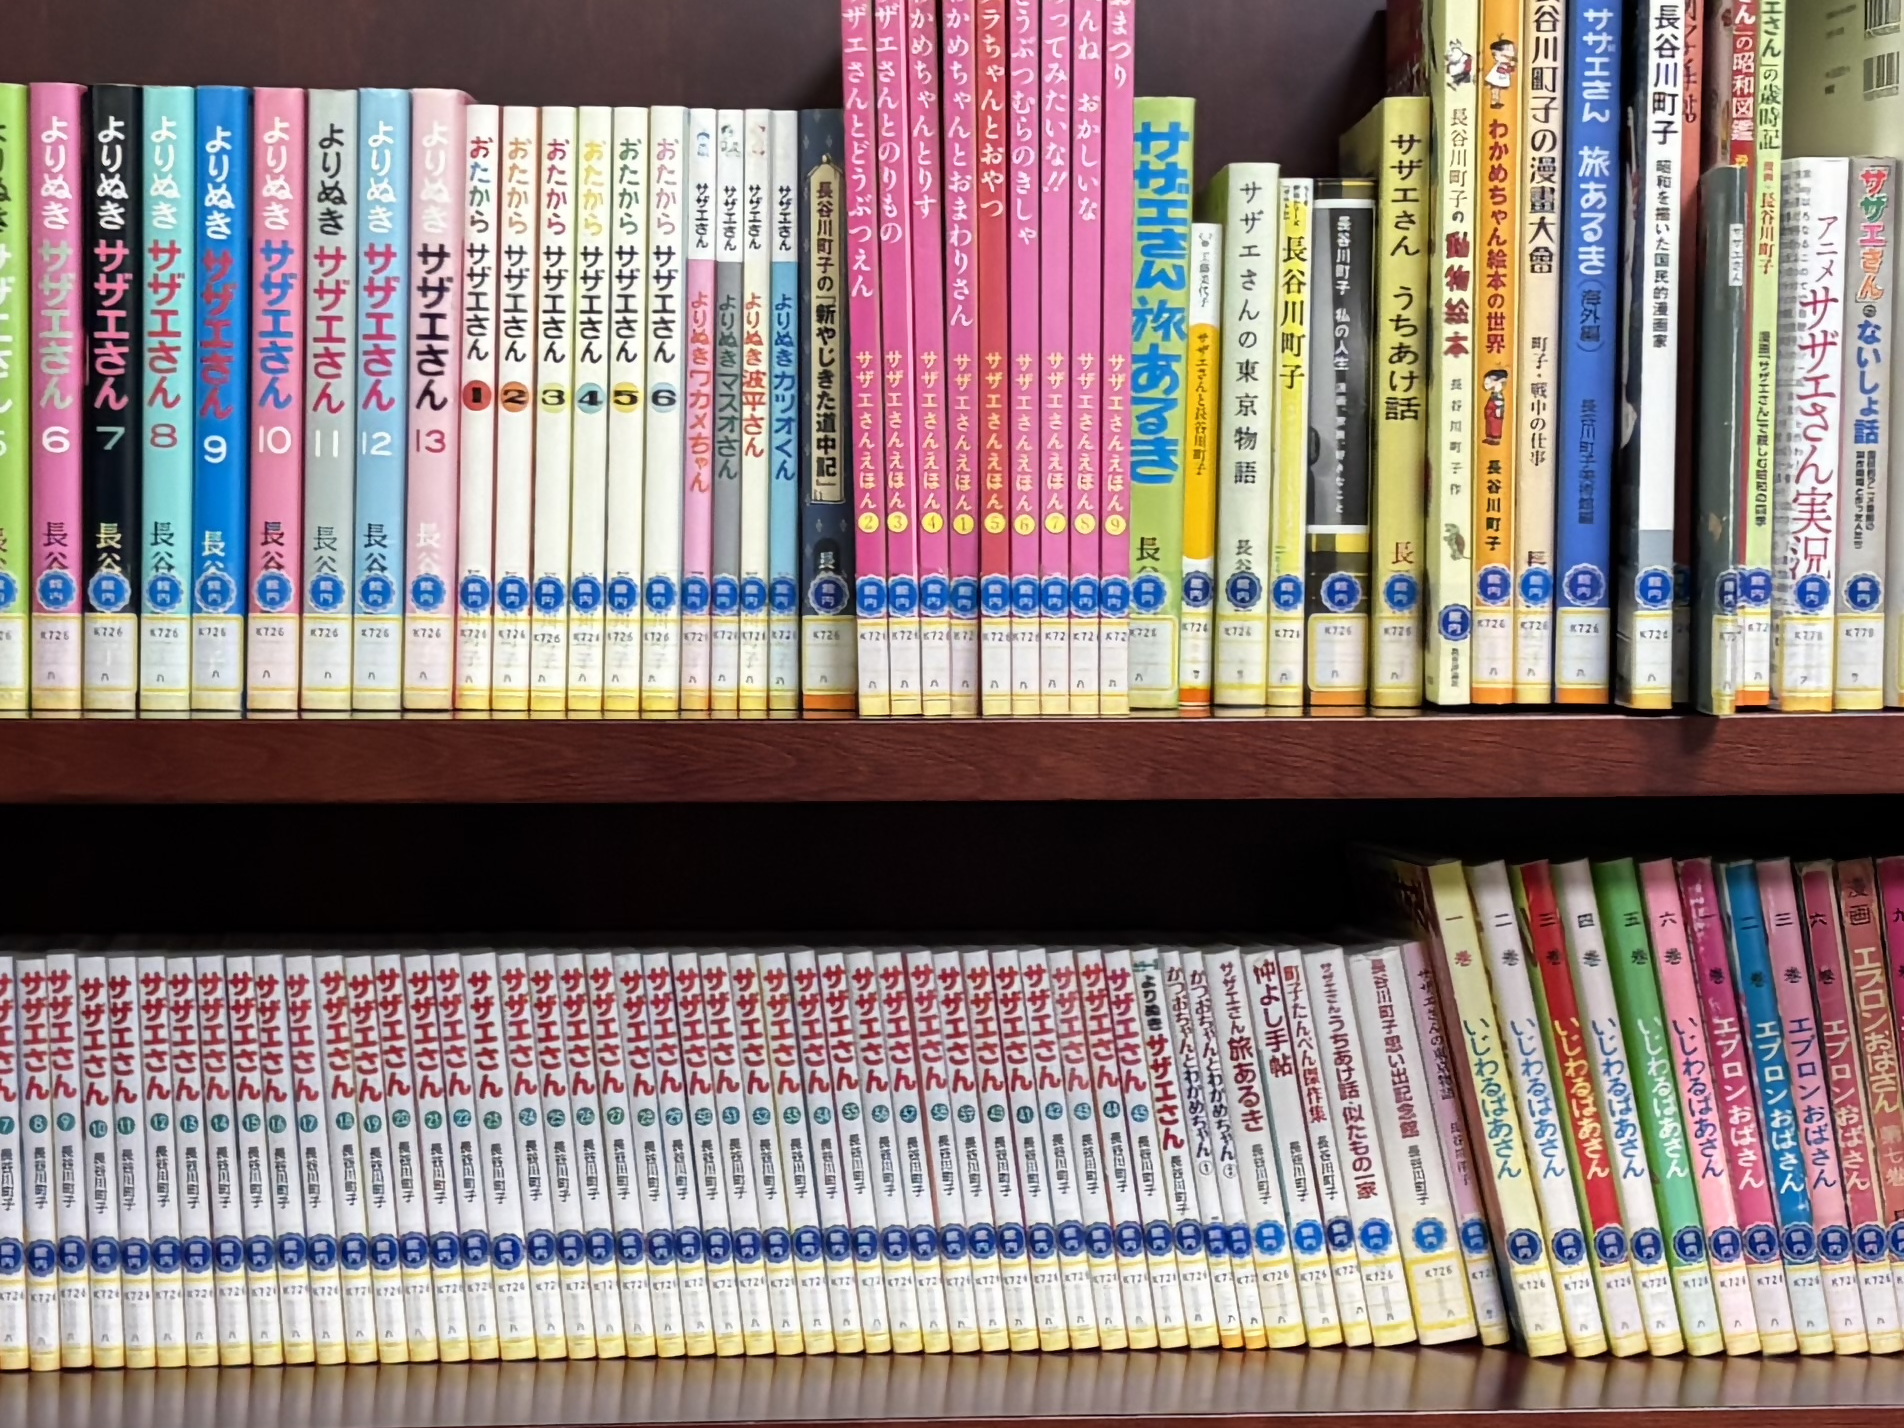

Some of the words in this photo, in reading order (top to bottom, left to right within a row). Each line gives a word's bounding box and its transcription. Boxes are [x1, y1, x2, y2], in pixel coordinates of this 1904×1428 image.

[1581, 8, 1616, 124] サザエさん
[1651, 5, 1681, 145] 長谷川町子
[694, 184, 708, 250] サザエさん
[723, 186, 737, 252] サザエさん
[748, 184, 764, 251] サザエさん
[778, 186, 791, 251] サザエさん
[1079, 94, 1100, 221] おかしいな
[1389, 133, 1423, 257] サザエさん
[1335, 216, 1351, 294] 長谷川町子
[1485, 120, 1510, 354] わかめちゃん絵本の世界
[1653, 160, 1672, 348] 昭和を描いた国民的漫画家
[1233, 182, 1263, 485] サザエさんの東京物語
[1280, 235, 1308, 391] 長谷川町子
[1384, 286, 1422, 421] うちあけ話
[42, 428, 70, 452] 6
[97, 427, 124, 450] 7
[150, 424, 177, 449] 8
[204, 435, 227, 463] 9
[258, 427, 291, 454] 10
[315, 431, 338, 457] 11
[362, 431, 392, 456] 12
[415, 429, 446, 453] 13
[856, 351, 878, 510] サザエさんえほん
[954, 354, 972, 513] サザエさんえほん
[985, 353, 1005, 510] サザエさんえほん
[1107, 354, 1125, 513] サザエさんえほん
[1484, 458, 1502, 551] 長谷川町子
[80, 978, 109, 1107] サザエさん
[502, 968, 537, 1096] サザエさん
[1110, 968, 1146, 1090] サザエさん
[1253, 959, 1293, 1077] 仲よし手帖
[1853, 947, 1899, 1114] エプロンおばさん
[1463, 1018, 1522, 1180] いじわるばあさん
[1510, 1019, 1565, 1178] いじわるばあさん
[1554, 1018, 1610, 1179] いじわるばあさん
[1714, 1017, 1764, 1190] エプロンおばさん
[1755, 1021, 1805, 1194] エプロンおばさん
